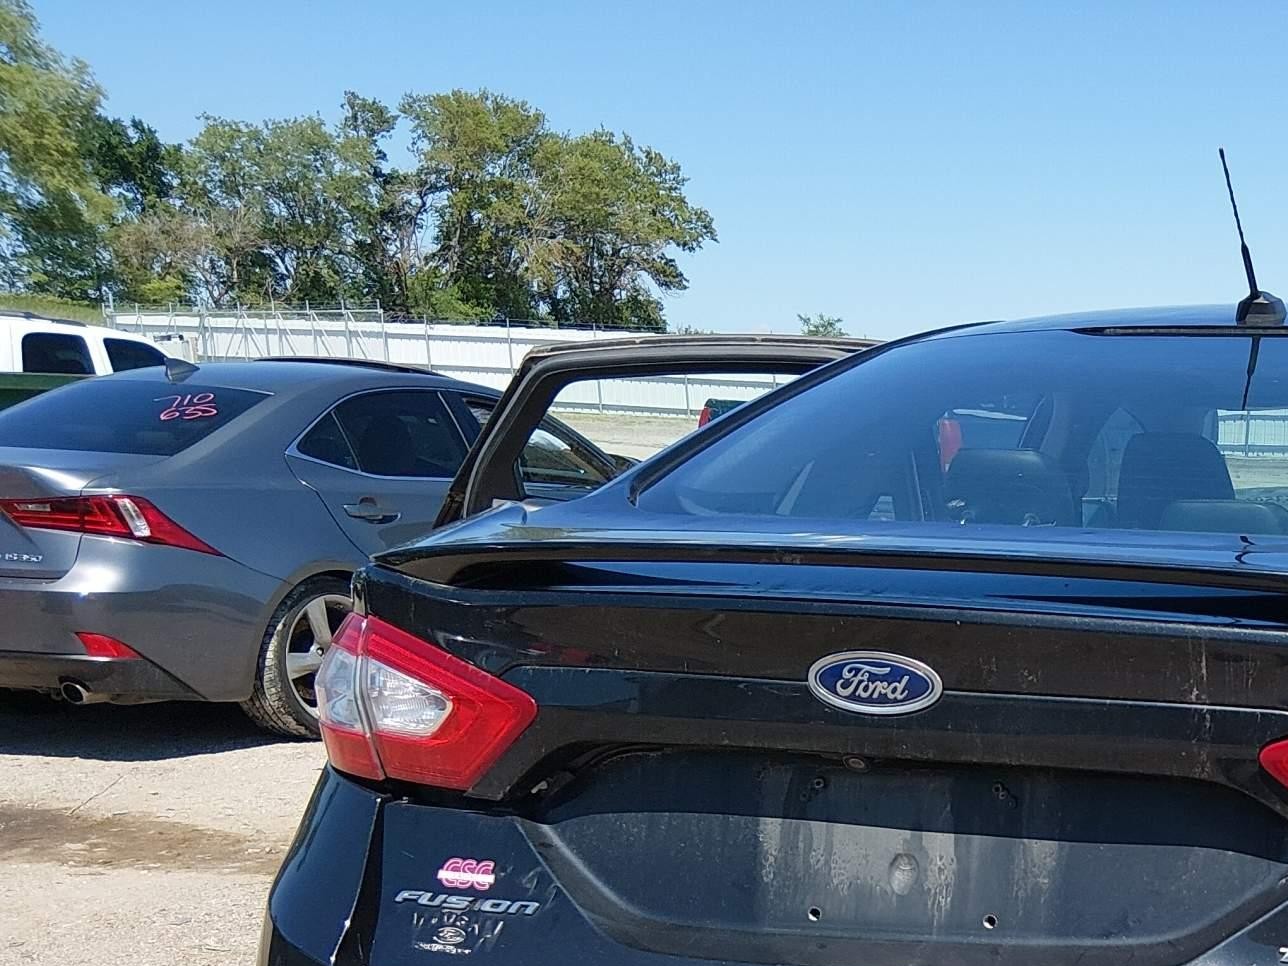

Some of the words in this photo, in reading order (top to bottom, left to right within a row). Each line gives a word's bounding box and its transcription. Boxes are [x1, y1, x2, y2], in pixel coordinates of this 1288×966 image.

[153, 392, 215, 407] 710
[836, 663, 910, 700] Ford
[394, 889, 541, 916] FUSION
